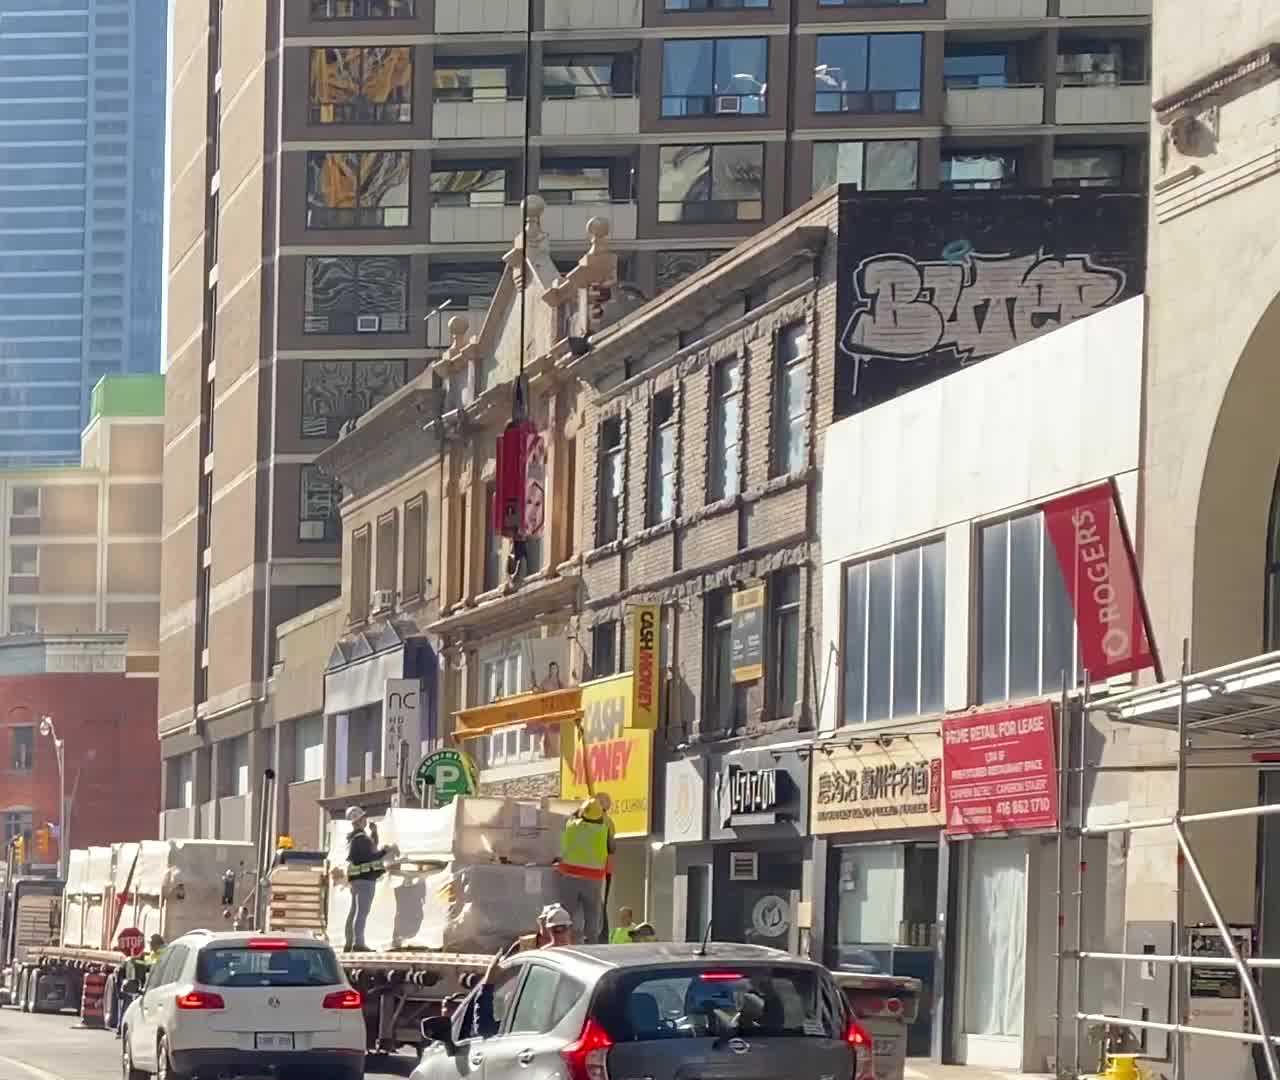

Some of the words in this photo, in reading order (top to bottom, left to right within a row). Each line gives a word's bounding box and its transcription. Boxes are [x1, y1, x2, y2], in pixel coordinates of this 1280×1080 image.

[1072, 507, 1121, 624] ROGERS
[640, 611, 654, 650] CASH
[639, 652, 653, 712] MONEY
[970, 723, 999, 742] RETAIL
[999, 719, 1017, 737] FOR
[1018, 715, 1045, 735] LEASE
[572, 738, 638, 784] MONEY
